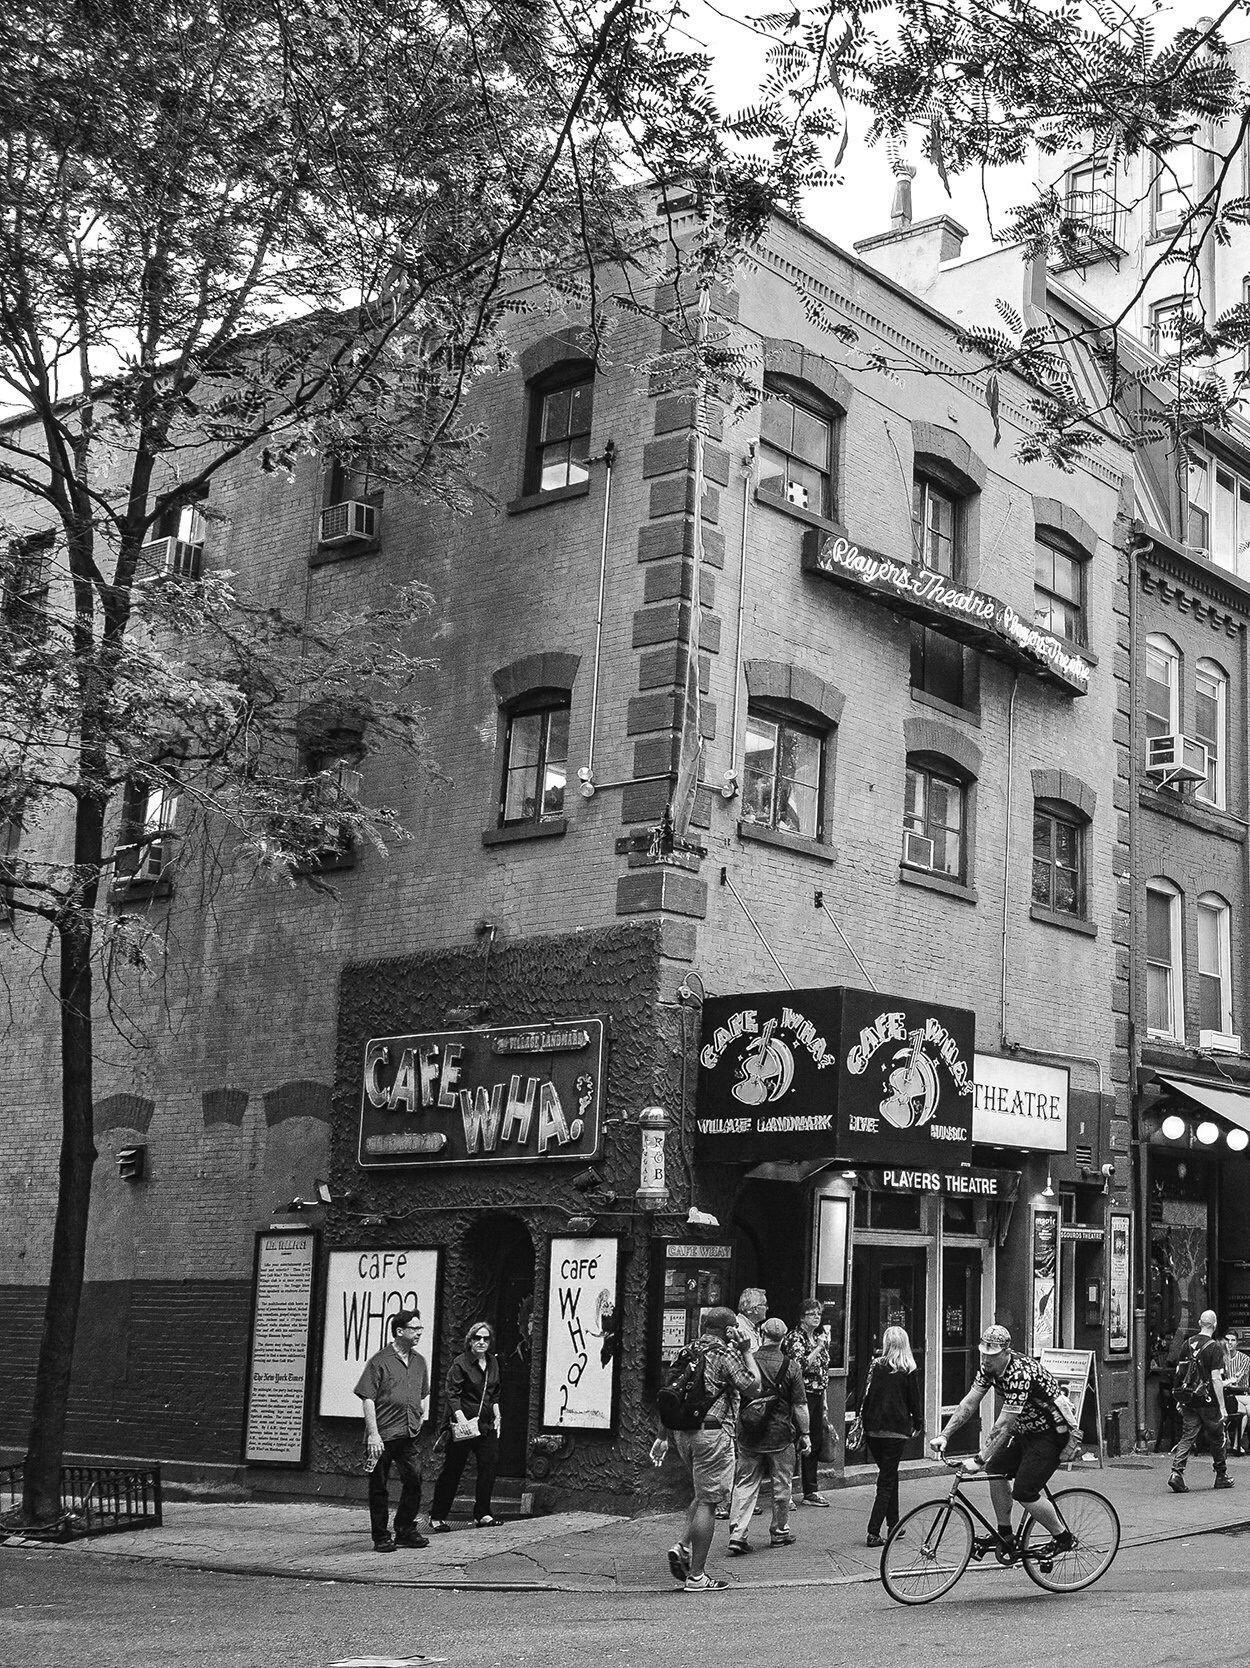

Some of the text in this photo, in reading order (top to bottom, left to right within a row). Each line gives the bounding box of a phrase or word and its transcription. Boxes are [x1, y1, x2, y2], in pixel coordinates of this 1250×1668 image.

[700, 1009, 758, 1069] CAFE
[846, 1012, 906, 1075] CAFE
[365, 1043, 464, 1112] CAFE
[973, 1082, 1061, 1121] THEATRE
[883, 1170, 998, 1195] PLAYERS THEATRE
